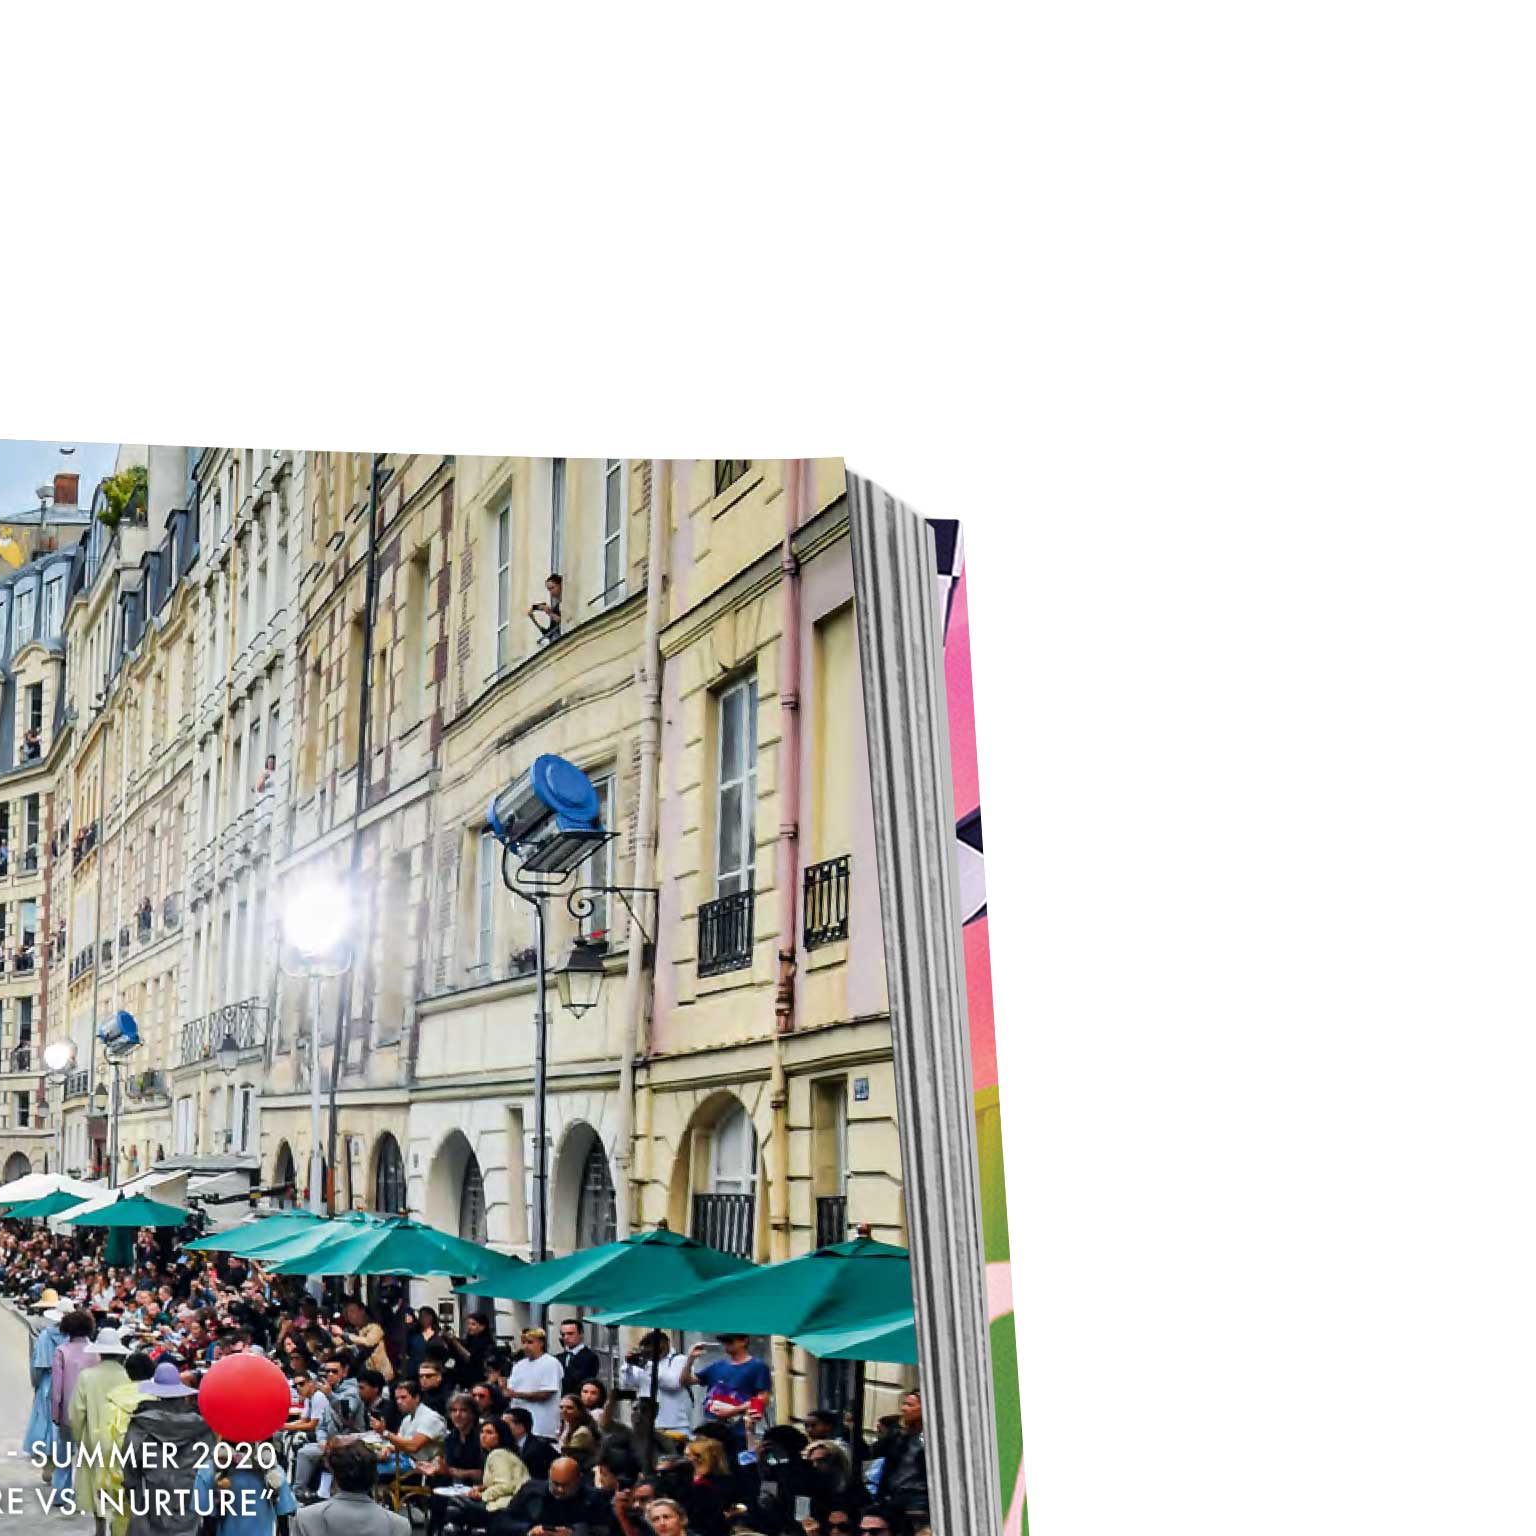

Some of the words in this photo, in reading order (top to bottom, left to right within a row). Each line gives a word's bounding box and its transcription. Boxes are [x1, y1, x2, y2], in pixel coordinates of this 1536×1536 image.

[30, 1440, 180, 1469] SUMMER
[191, 1441, 276, 1470] 2020
[35, 1487, 86, 1516] VS.
[100, 1488, 274, 1517] NURTURE”
